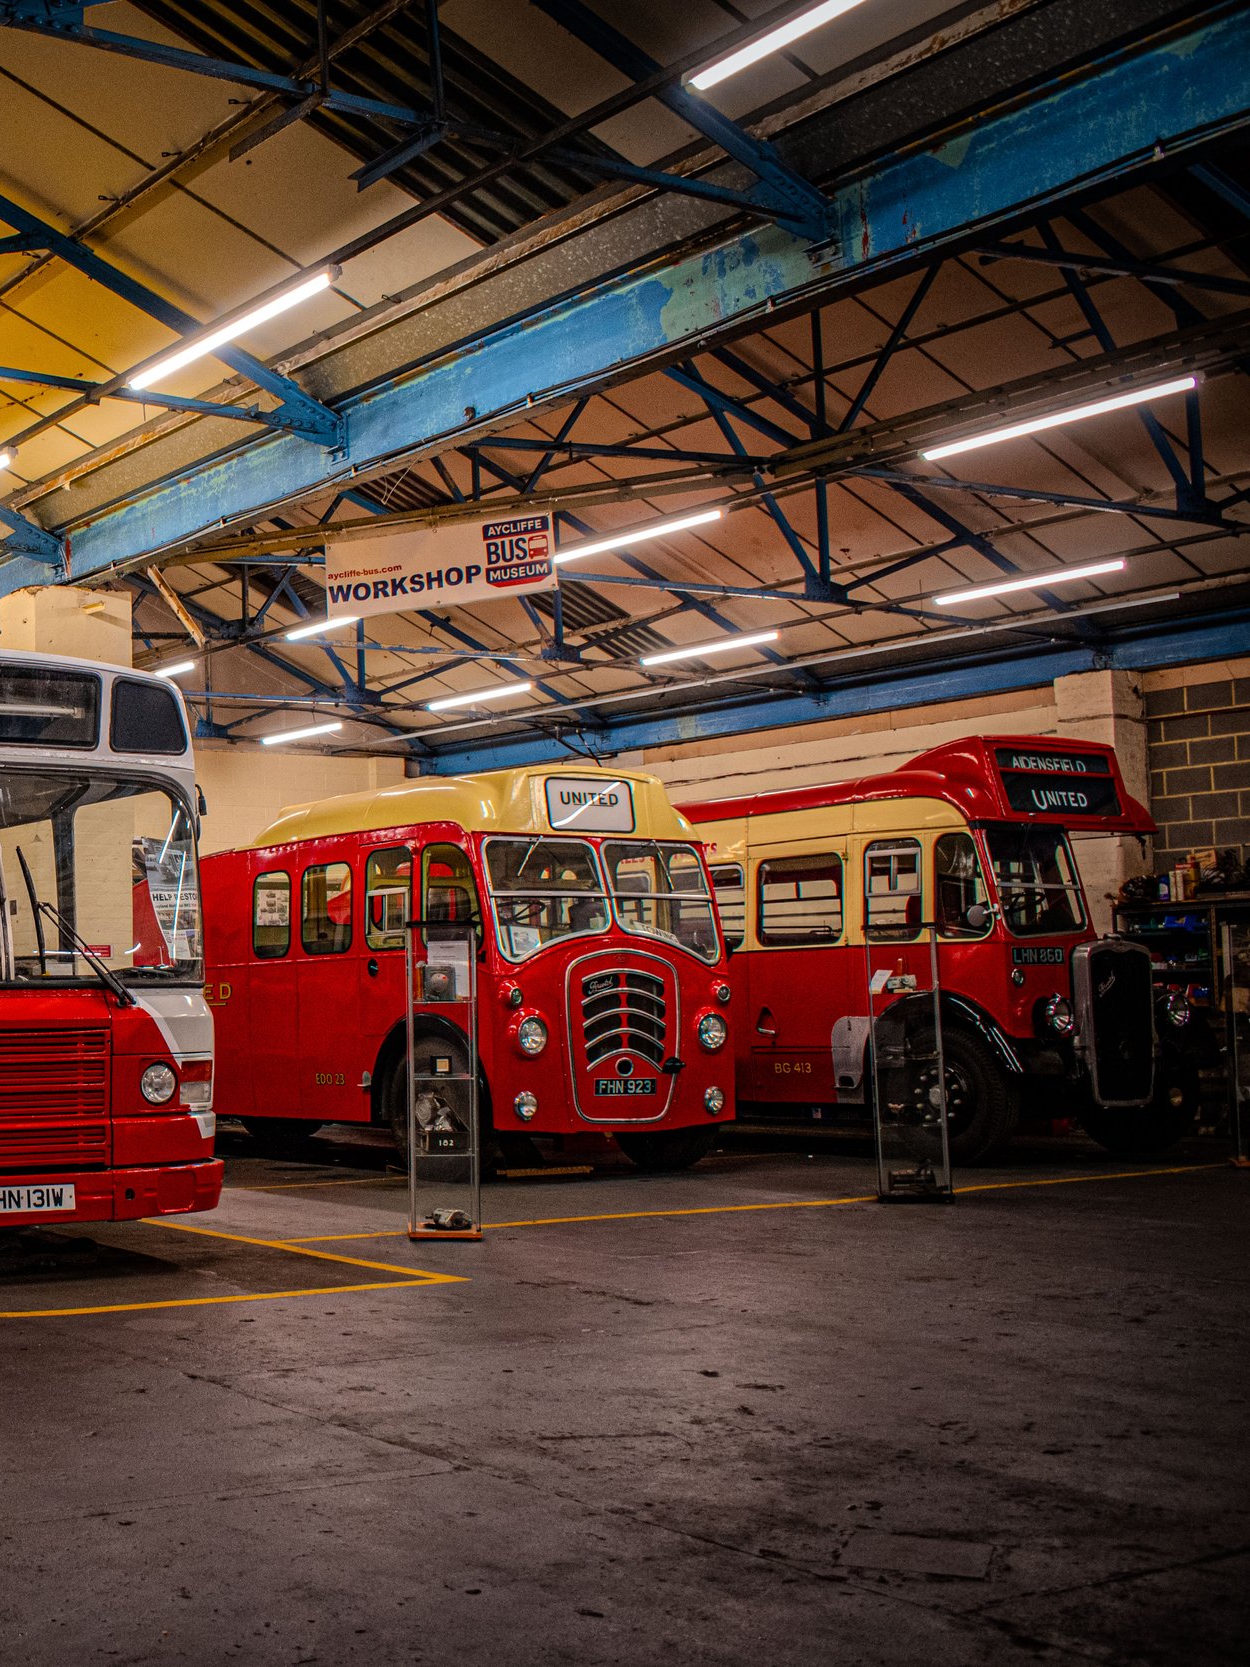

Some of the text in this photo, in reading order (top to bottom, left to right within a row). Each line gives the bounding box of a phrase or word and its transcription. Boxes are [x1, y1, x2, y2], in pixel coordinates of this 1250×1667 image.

[487, 518, 543, 537] AYCLIFFE
[485, 536, 529, 566] BUS
[327, 563, 403, 581] aycliffe-bus.com
[489, 562, 549, 583] MUSEUM
[328, 563, 483, 605] WORKSHOP
[559, 791, 619, 806] UNITED
[1030, 789, 1089, 811] UNITED
[152, 892, 173, 902] HELP
[1013, 948, 1063, 964] LHN 860
[774, 1062, 812, 1074] BG 413
[335, 1072, 345, 1085] 23
[598, 1079, 652, 1094] FHN 923
[26, 1187, 65, 1209] 131W
